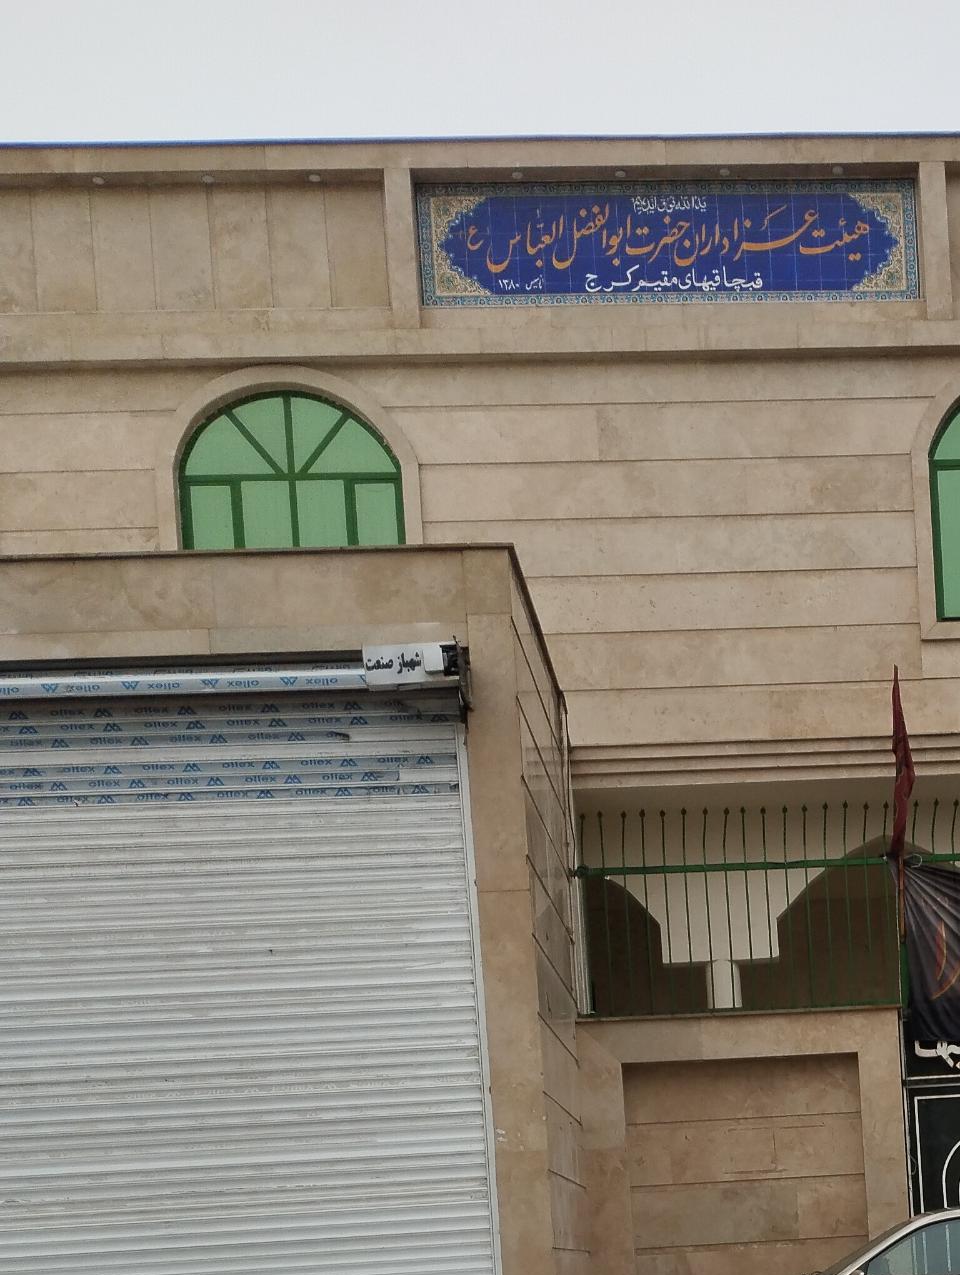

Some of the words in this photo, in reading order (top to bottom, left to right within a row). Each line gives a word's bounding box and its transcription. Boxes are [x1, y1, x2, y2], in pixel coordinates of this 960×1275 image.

[552, 202, 631, 270] ابوالفضل
[625, 214, 691, 264] حضرت
[585, 263, 641, 293] کرج
[631, 270, 679, 293] مقیم
[365, 656, 394, 672] صنعت
[397, 651, 422, 674] شهباز
